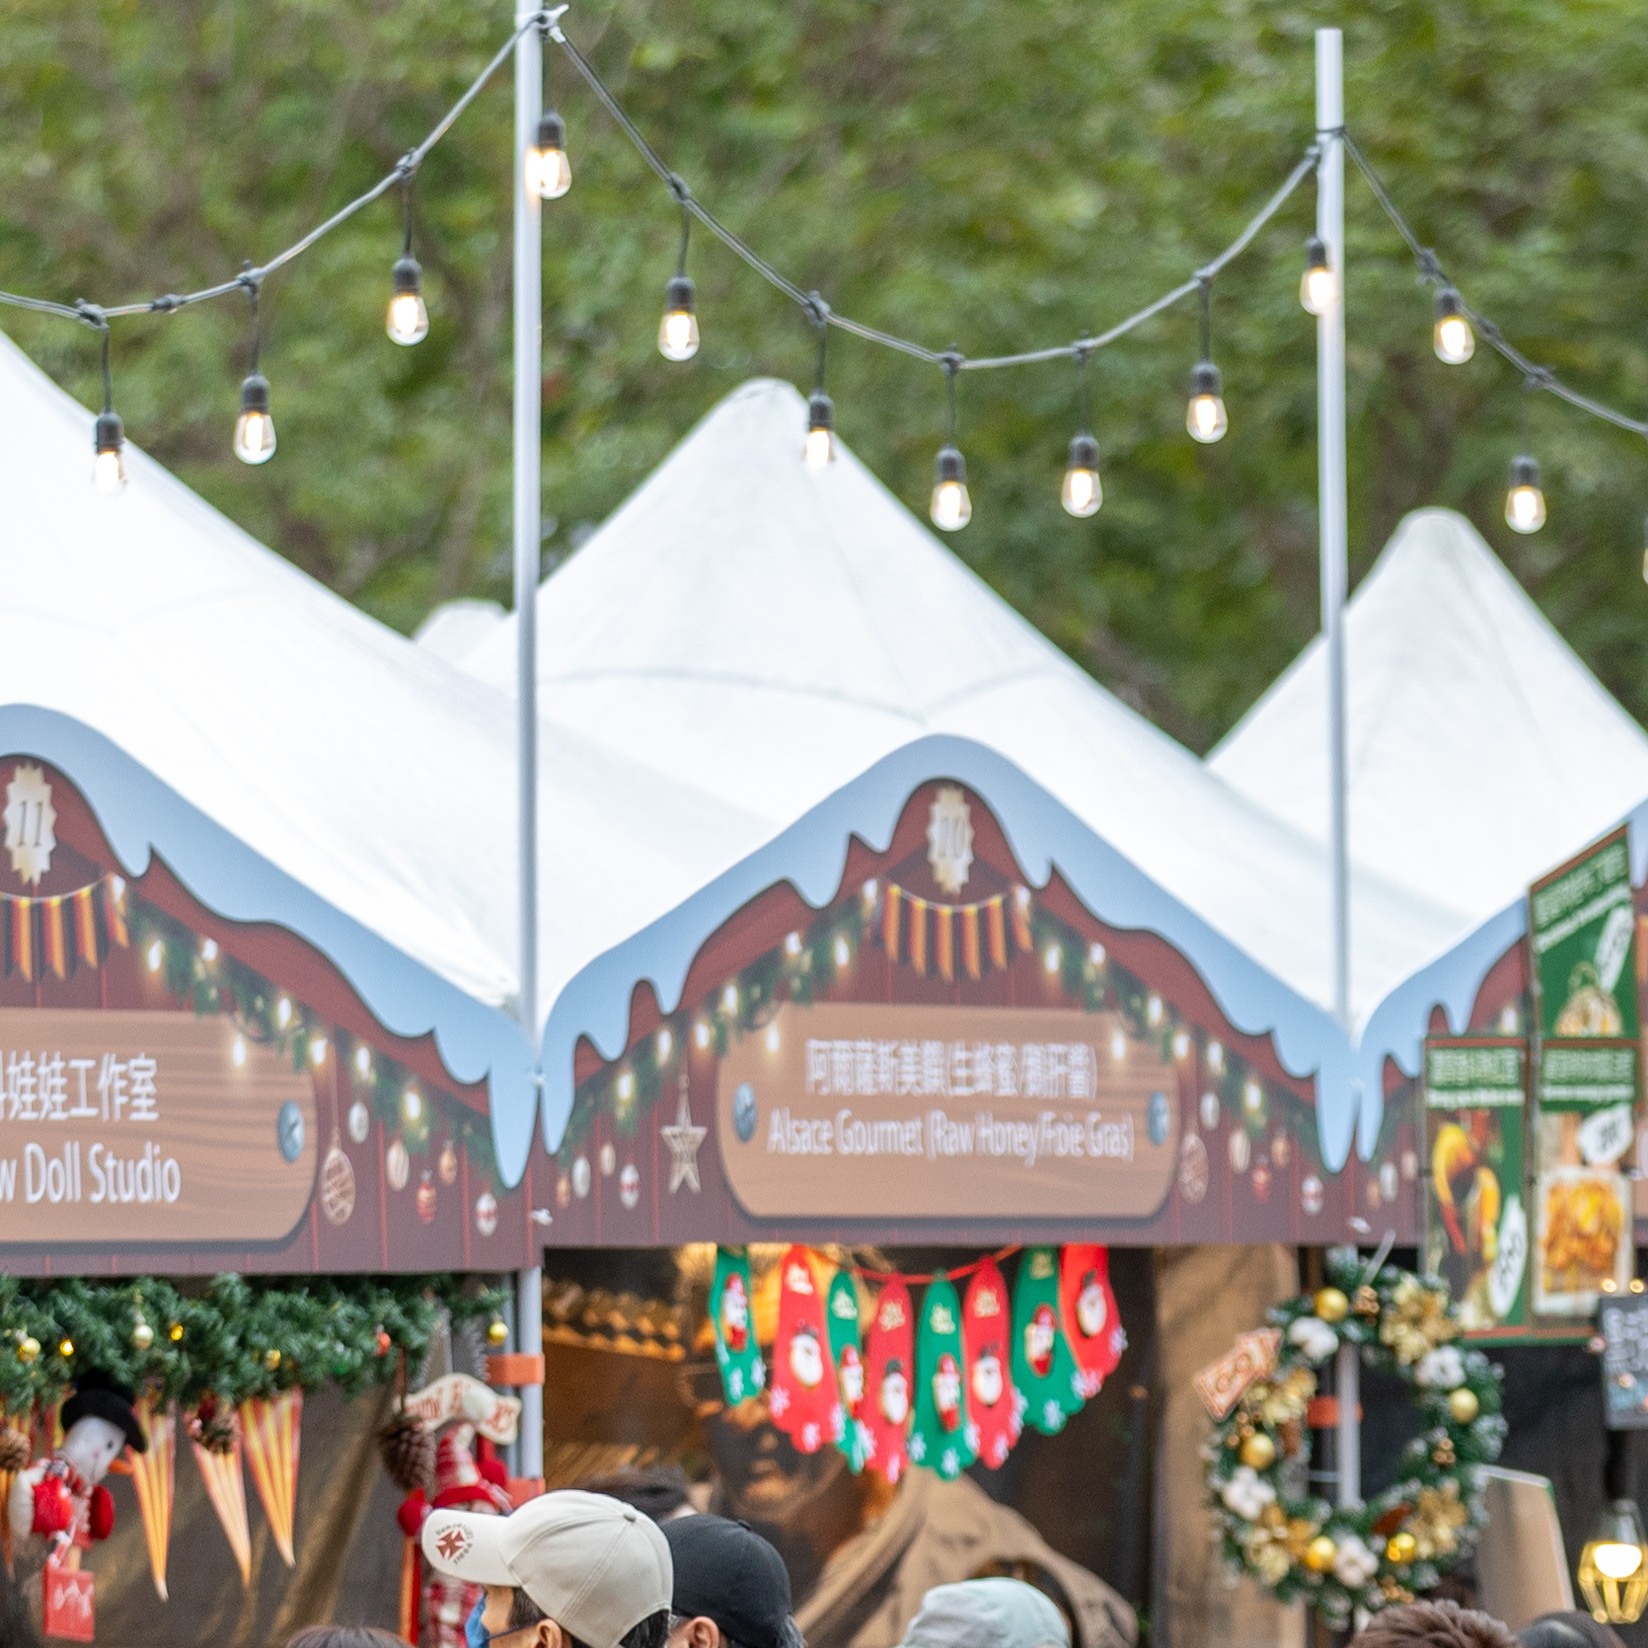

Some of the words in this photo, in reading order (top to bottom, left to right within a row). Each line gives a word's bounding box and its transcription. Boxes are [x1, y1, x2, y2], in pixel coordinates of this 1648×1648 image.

[17, 800, 43, 848] 11
[767, 1106, 835, 1156] Alsace
[835, 1108, 925, 1157] Gourmet
[926, 1108, 975, 1162] (Raw
[1085, 1110, 1136, 1164] Gras)
[24, 1140, 82, 1204] Doll
[88, 1140, 182, 1204] Studio
